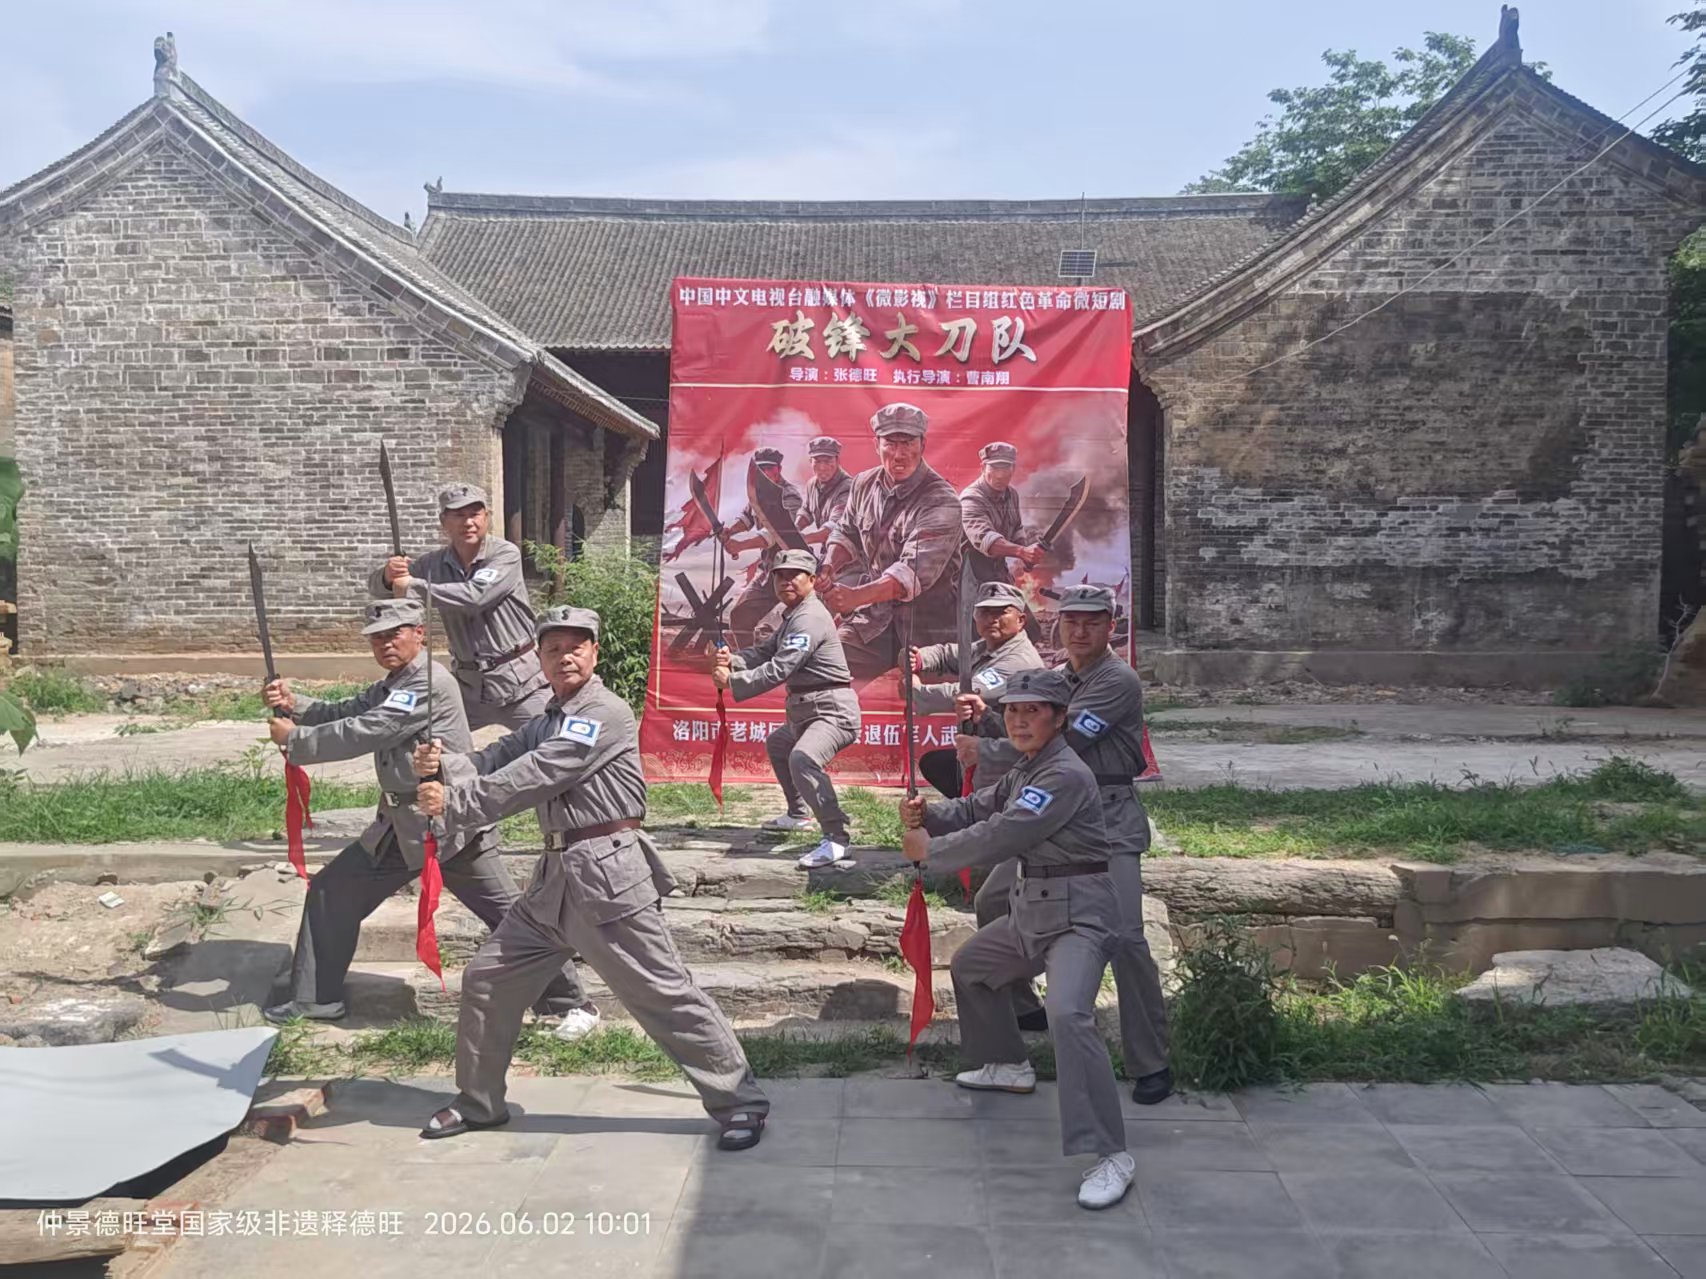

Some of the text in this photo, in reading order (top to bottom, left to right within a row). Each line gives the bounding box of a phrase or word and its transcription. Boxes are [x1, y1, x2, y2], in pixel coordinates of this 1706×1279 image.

[766, 309, 1037, 365] 破锋大刀队
